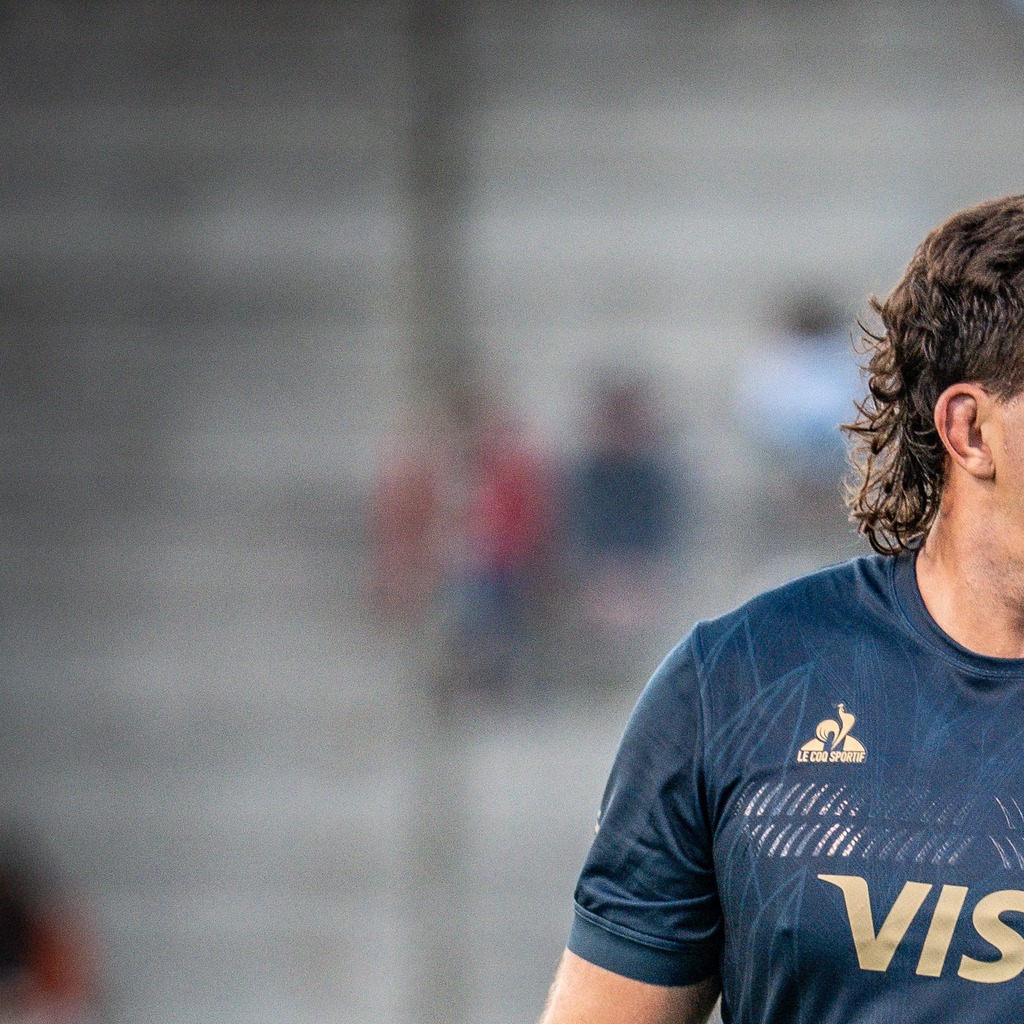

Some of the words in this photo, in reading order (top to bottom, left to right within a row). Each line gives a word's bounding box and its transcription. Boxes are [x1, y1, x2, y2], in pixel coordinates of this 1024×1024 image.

[797, 750, 809, 762] LE
[810, 750, 828, 762] COQ
[829, 750, 866, 762] SPORTIF
